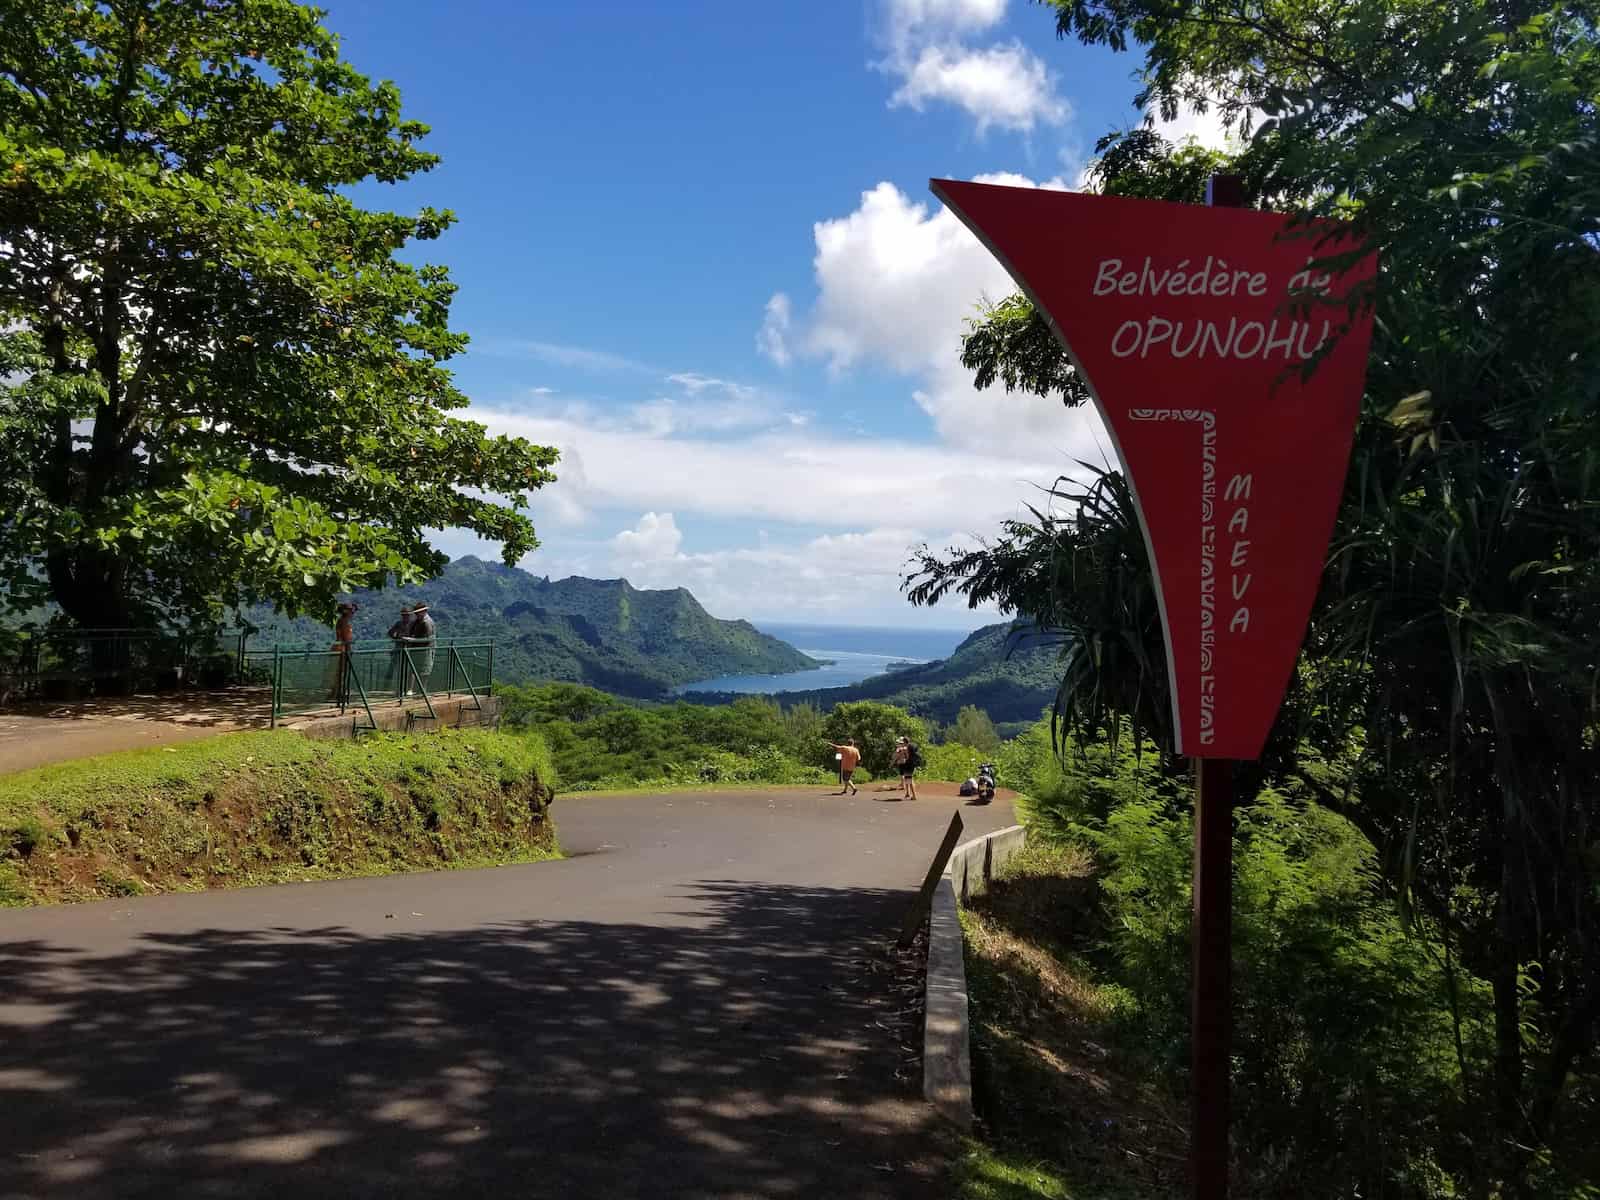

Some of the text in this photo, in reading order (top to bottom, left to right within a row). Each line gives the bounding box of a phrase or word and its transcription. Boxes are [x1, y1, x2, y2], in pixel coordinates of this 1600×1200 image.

[1093, 256, 1268, 296] Belvédère
[1111, 315, 1330, 359] OPUNOHU
[1224, 474, 1252, 633] MAEVA
